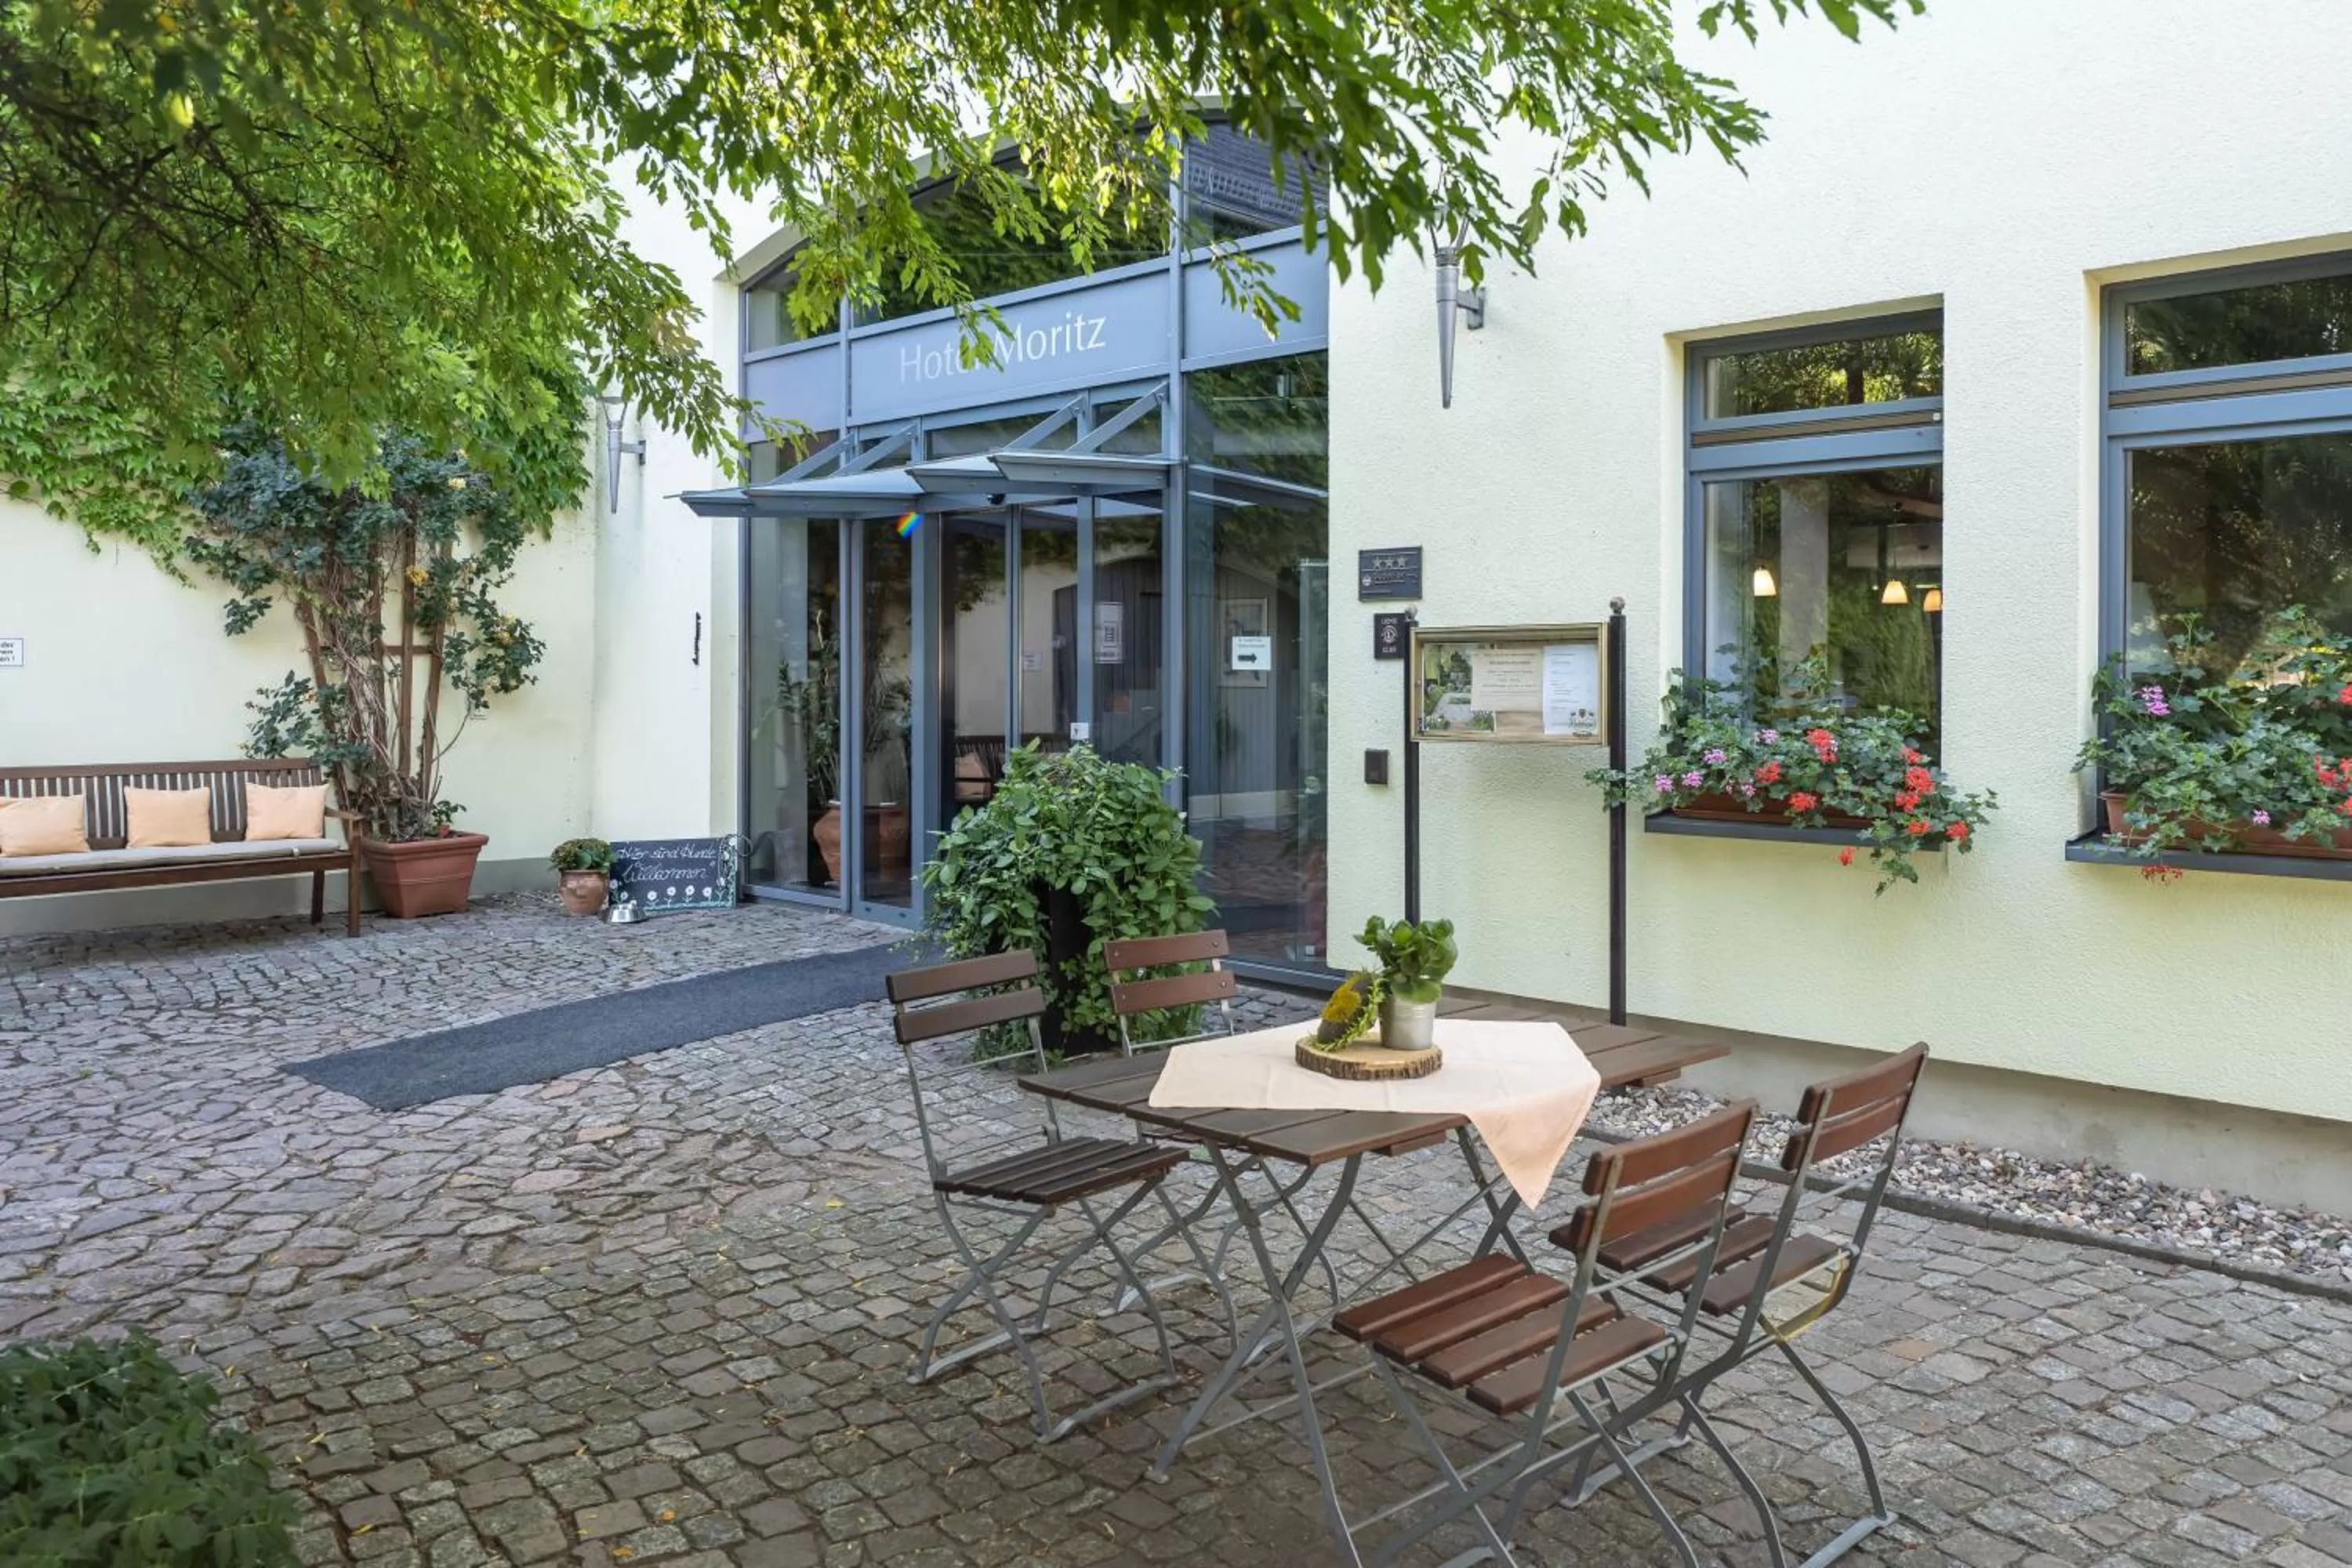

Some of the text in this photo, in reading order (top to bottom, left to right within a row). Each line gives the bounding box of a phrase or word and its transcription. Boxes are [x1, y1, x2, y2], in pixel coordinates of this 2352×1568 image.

[901, 310, 1107, 383] Hot Moritz
[650, 846, 680, 858] sind
